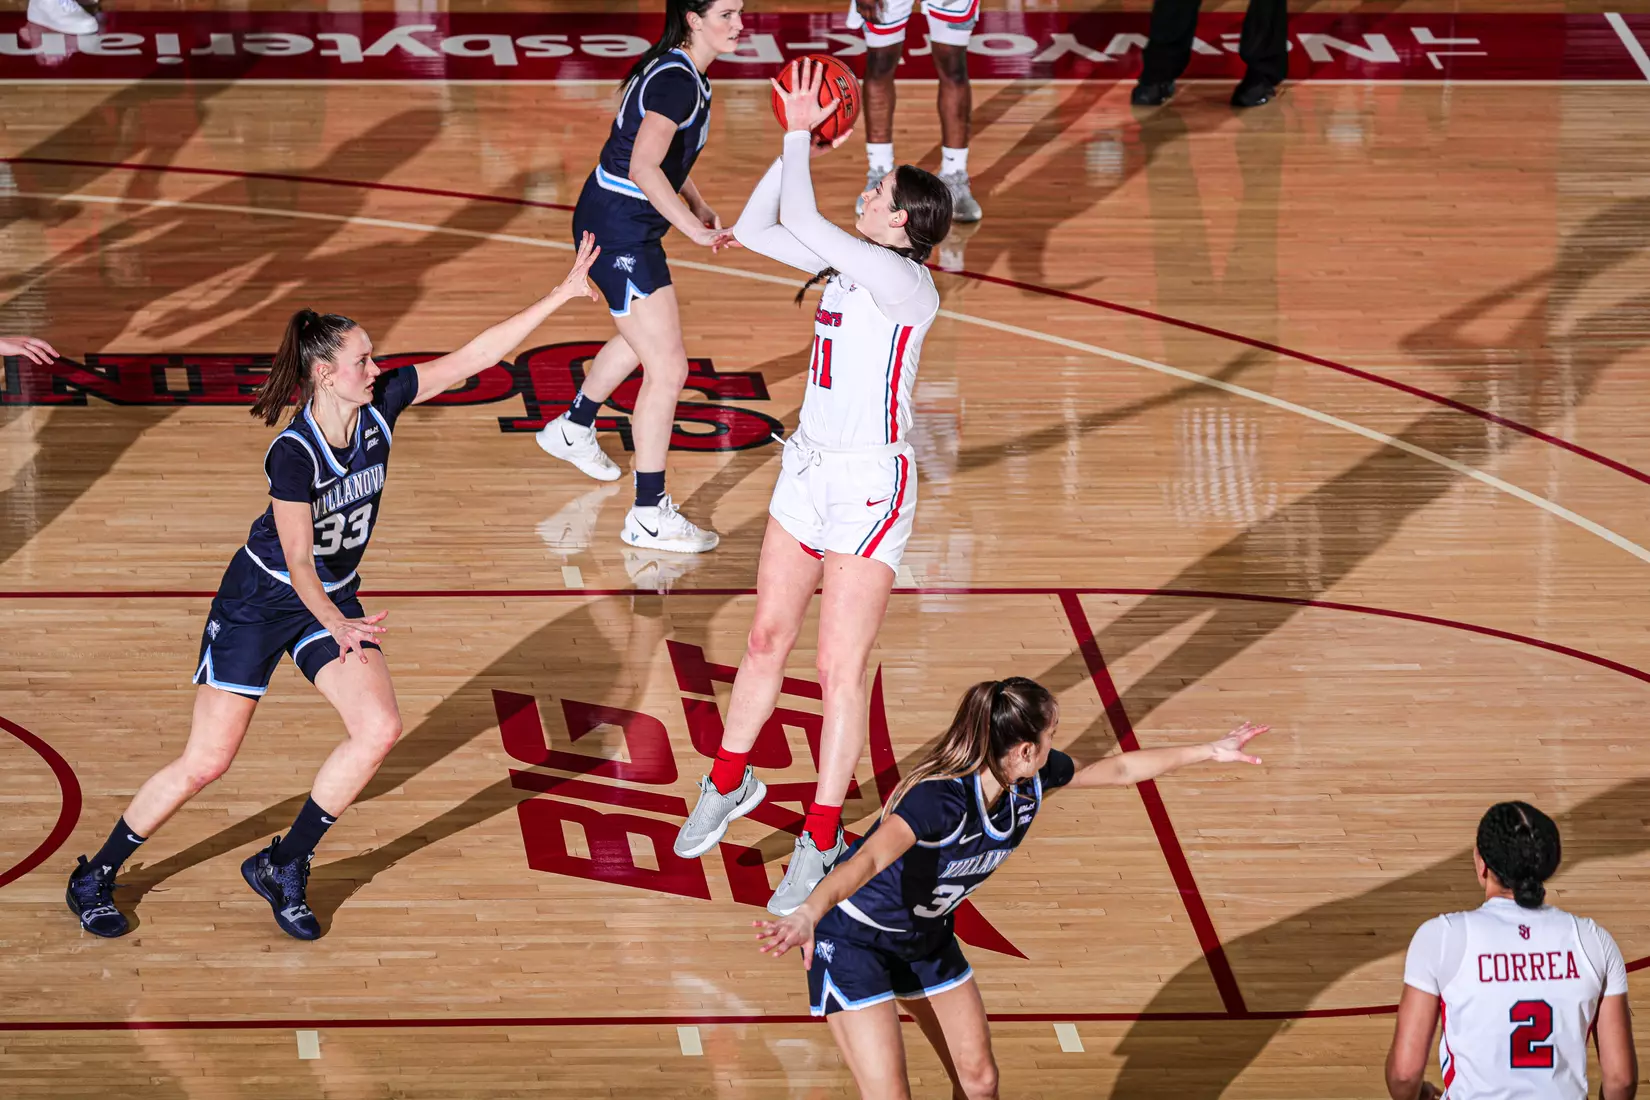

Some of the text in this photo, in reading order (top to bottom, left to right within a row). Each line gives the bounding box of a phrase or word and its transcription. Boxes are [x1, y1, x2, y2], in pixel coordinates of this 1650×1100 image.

[811, 334, 833, 390] 11
[312, 463, 385, 520] VILLANOVA
[312, 503, 373, 557] 33
[491, 688, 712, 901] BIG
[937, 848, 1014, 879] VILLAN
[912, 883, 985, 919] 3
[1477, 950, 1581, 984] CORREA
[1508, 999, 1555, 1069] 2
